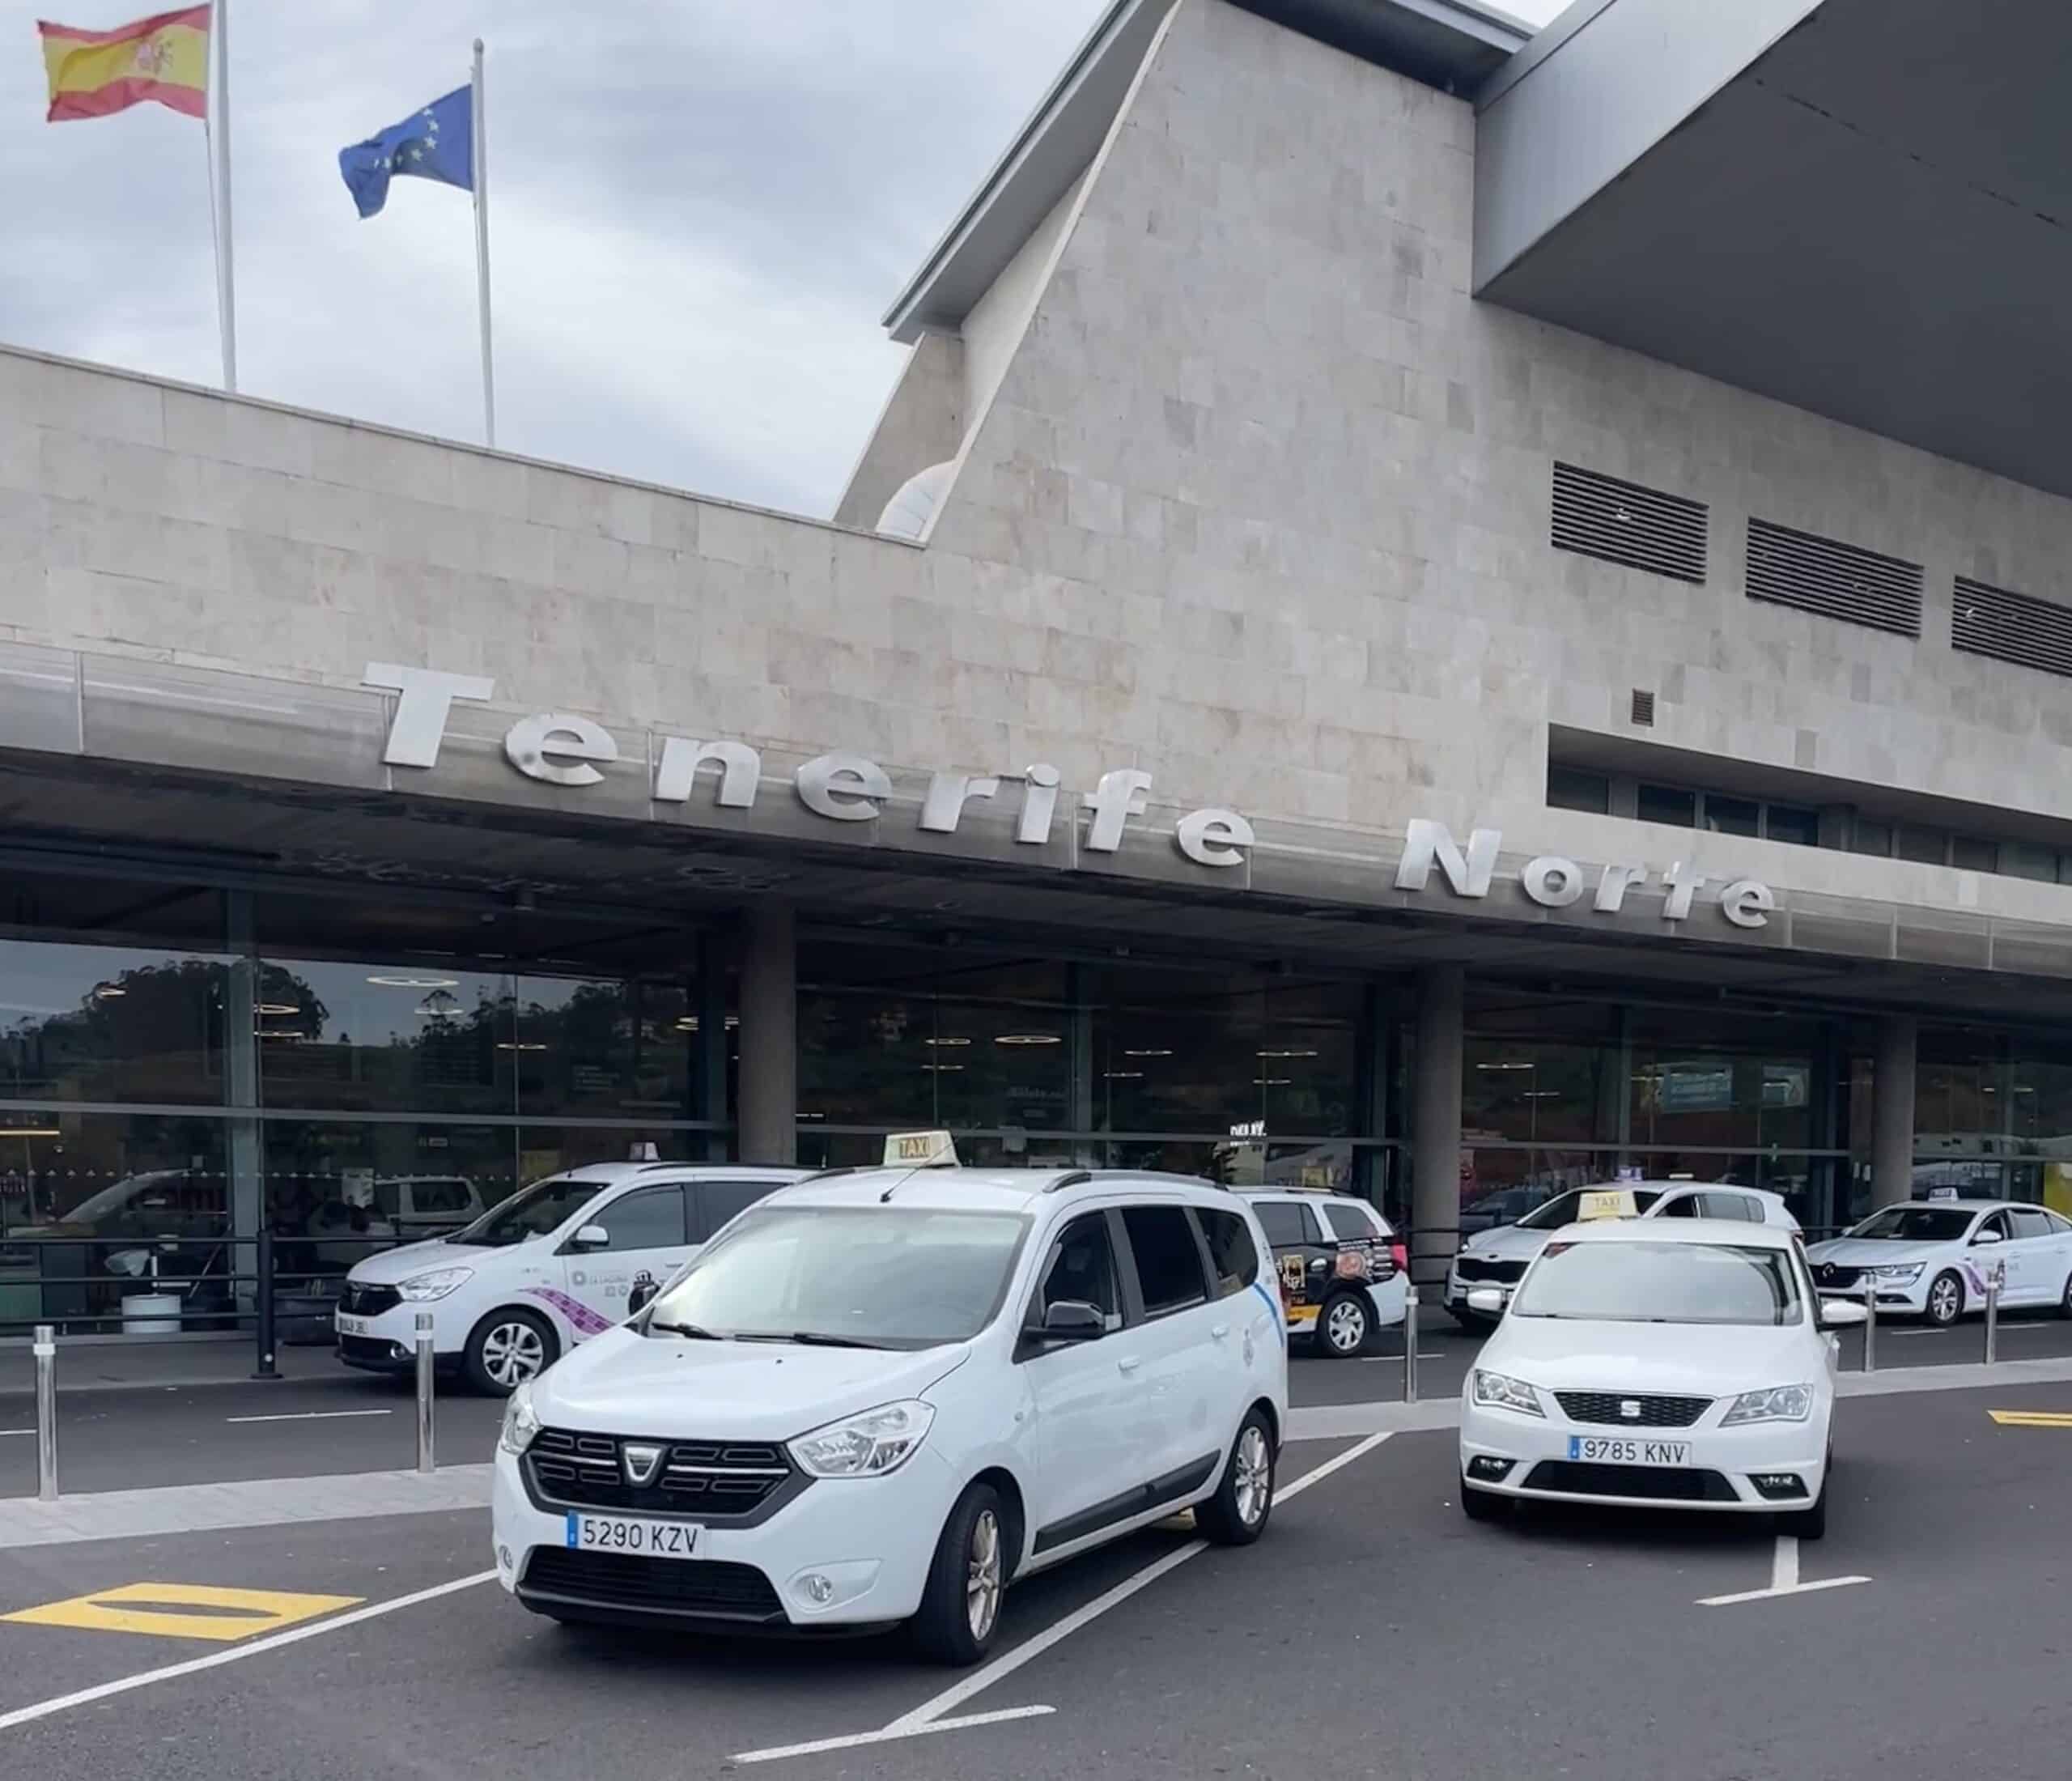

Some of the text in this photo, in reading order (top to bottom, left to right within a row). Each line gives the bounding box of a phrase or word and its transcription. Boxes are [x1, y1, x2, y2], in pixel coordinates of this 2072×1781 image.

[360, 661, 1776, 929] Tenerife Norte
[900, 1137, 930, 1157] TAXI
[1584, 1440, 1685, 1464] 9785 KNV
[583, 1519, 698, 1554] 5290 KZV
